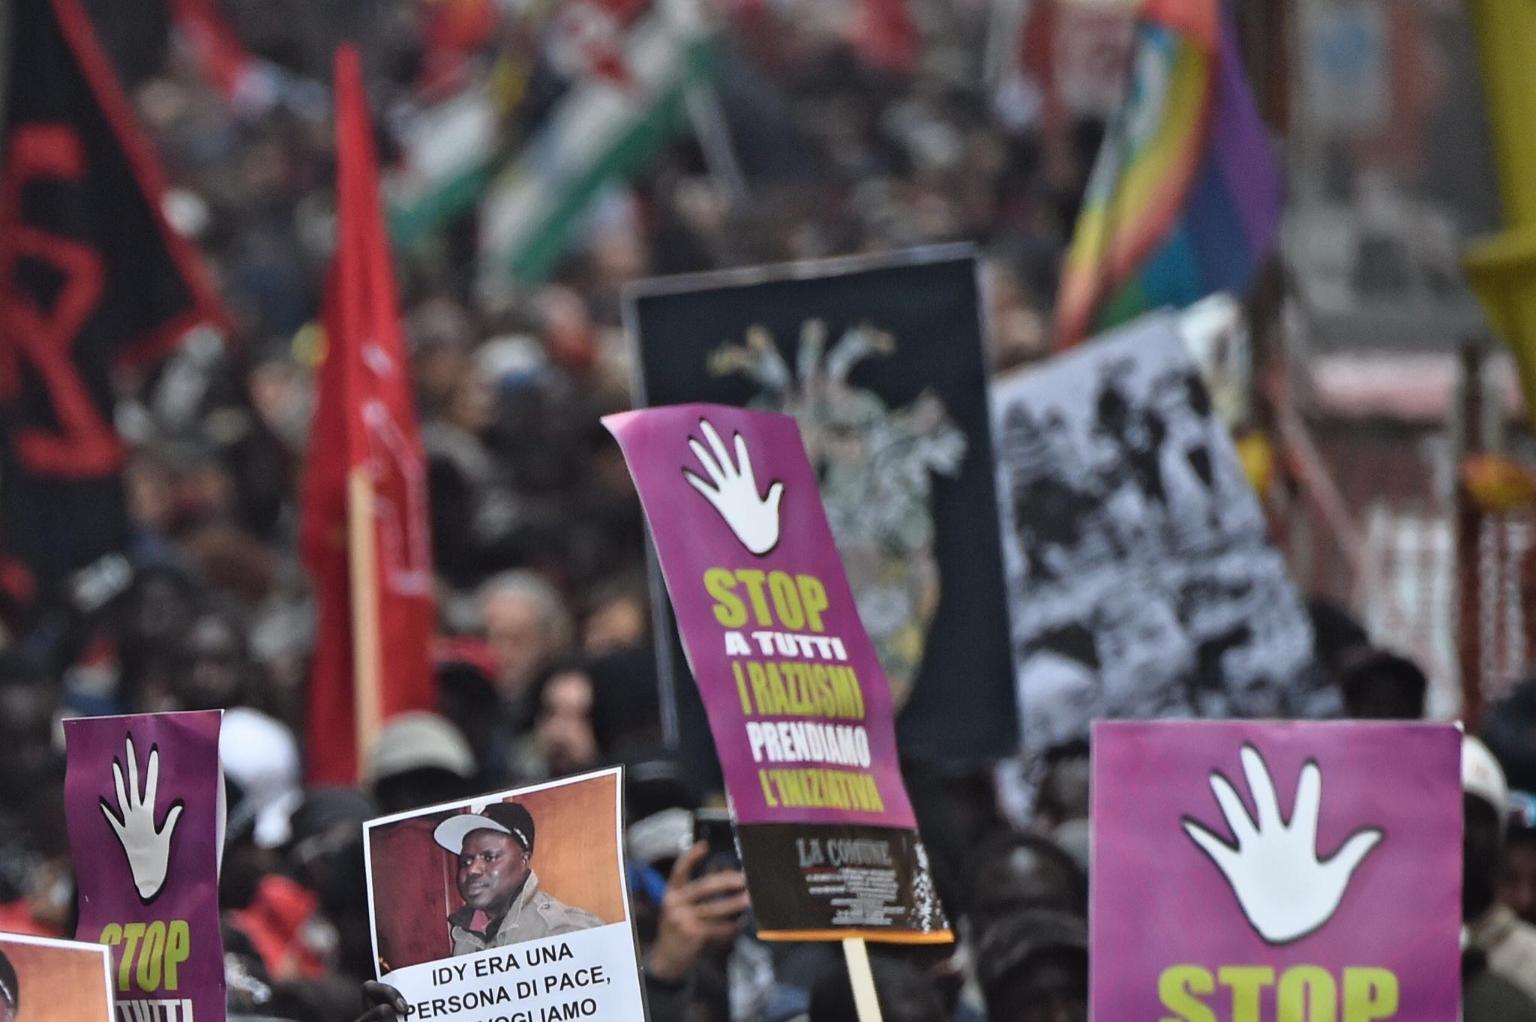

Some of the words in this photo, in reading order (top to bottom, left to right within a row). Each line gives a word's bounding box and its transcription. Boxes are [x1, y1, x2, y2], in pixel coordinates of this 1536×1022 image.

[704, 567, 829, 632] STOP
[725, 631, 751, 655] A
[751, 631, 848, 660] TUTTI
[733, 661, 752, 715] I
[747, 661, 865, 720] RAZZISMI
[746, 722, 871, 768] PRENDIAMO
[759, 769, 884, 813] L'INIZIATIVA
[796, 838, 824, 867] LA
[827, 839, 892, 866] COMUNE
[433, 964, 467, 986] IDY
[475, 954, 520, 977] ERA
[526, 943, 573, 967] UNA
[404, 986, 511, 1022] PERSONA
[517, 980, 538, 999] DI
[545, 966, 611, 993] PACE,
